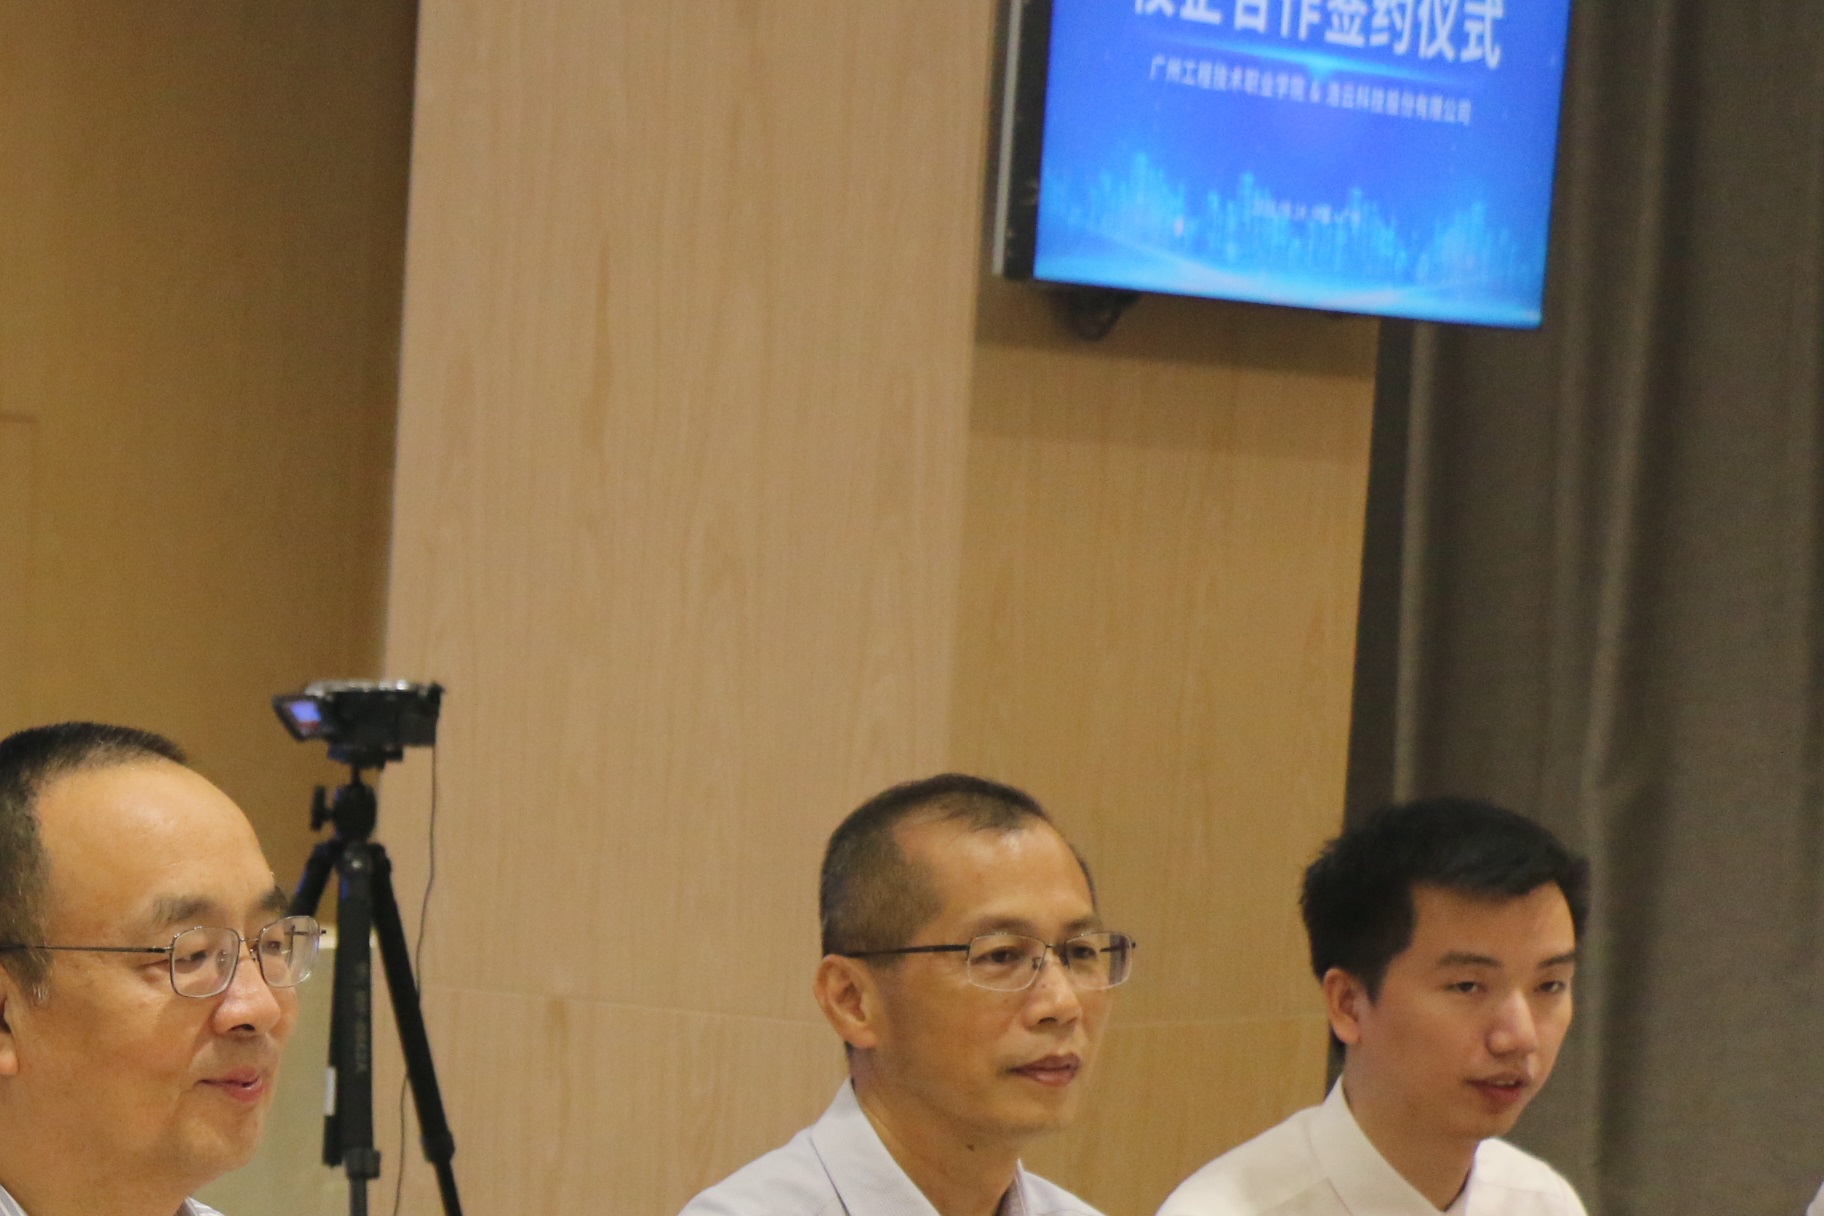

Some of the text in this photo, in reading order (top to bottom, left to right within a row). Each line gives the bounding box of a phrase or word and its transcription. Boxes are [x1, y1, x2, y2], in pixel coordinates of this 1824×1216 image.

[1135, 0, 1504, 69] 作签约仪式
